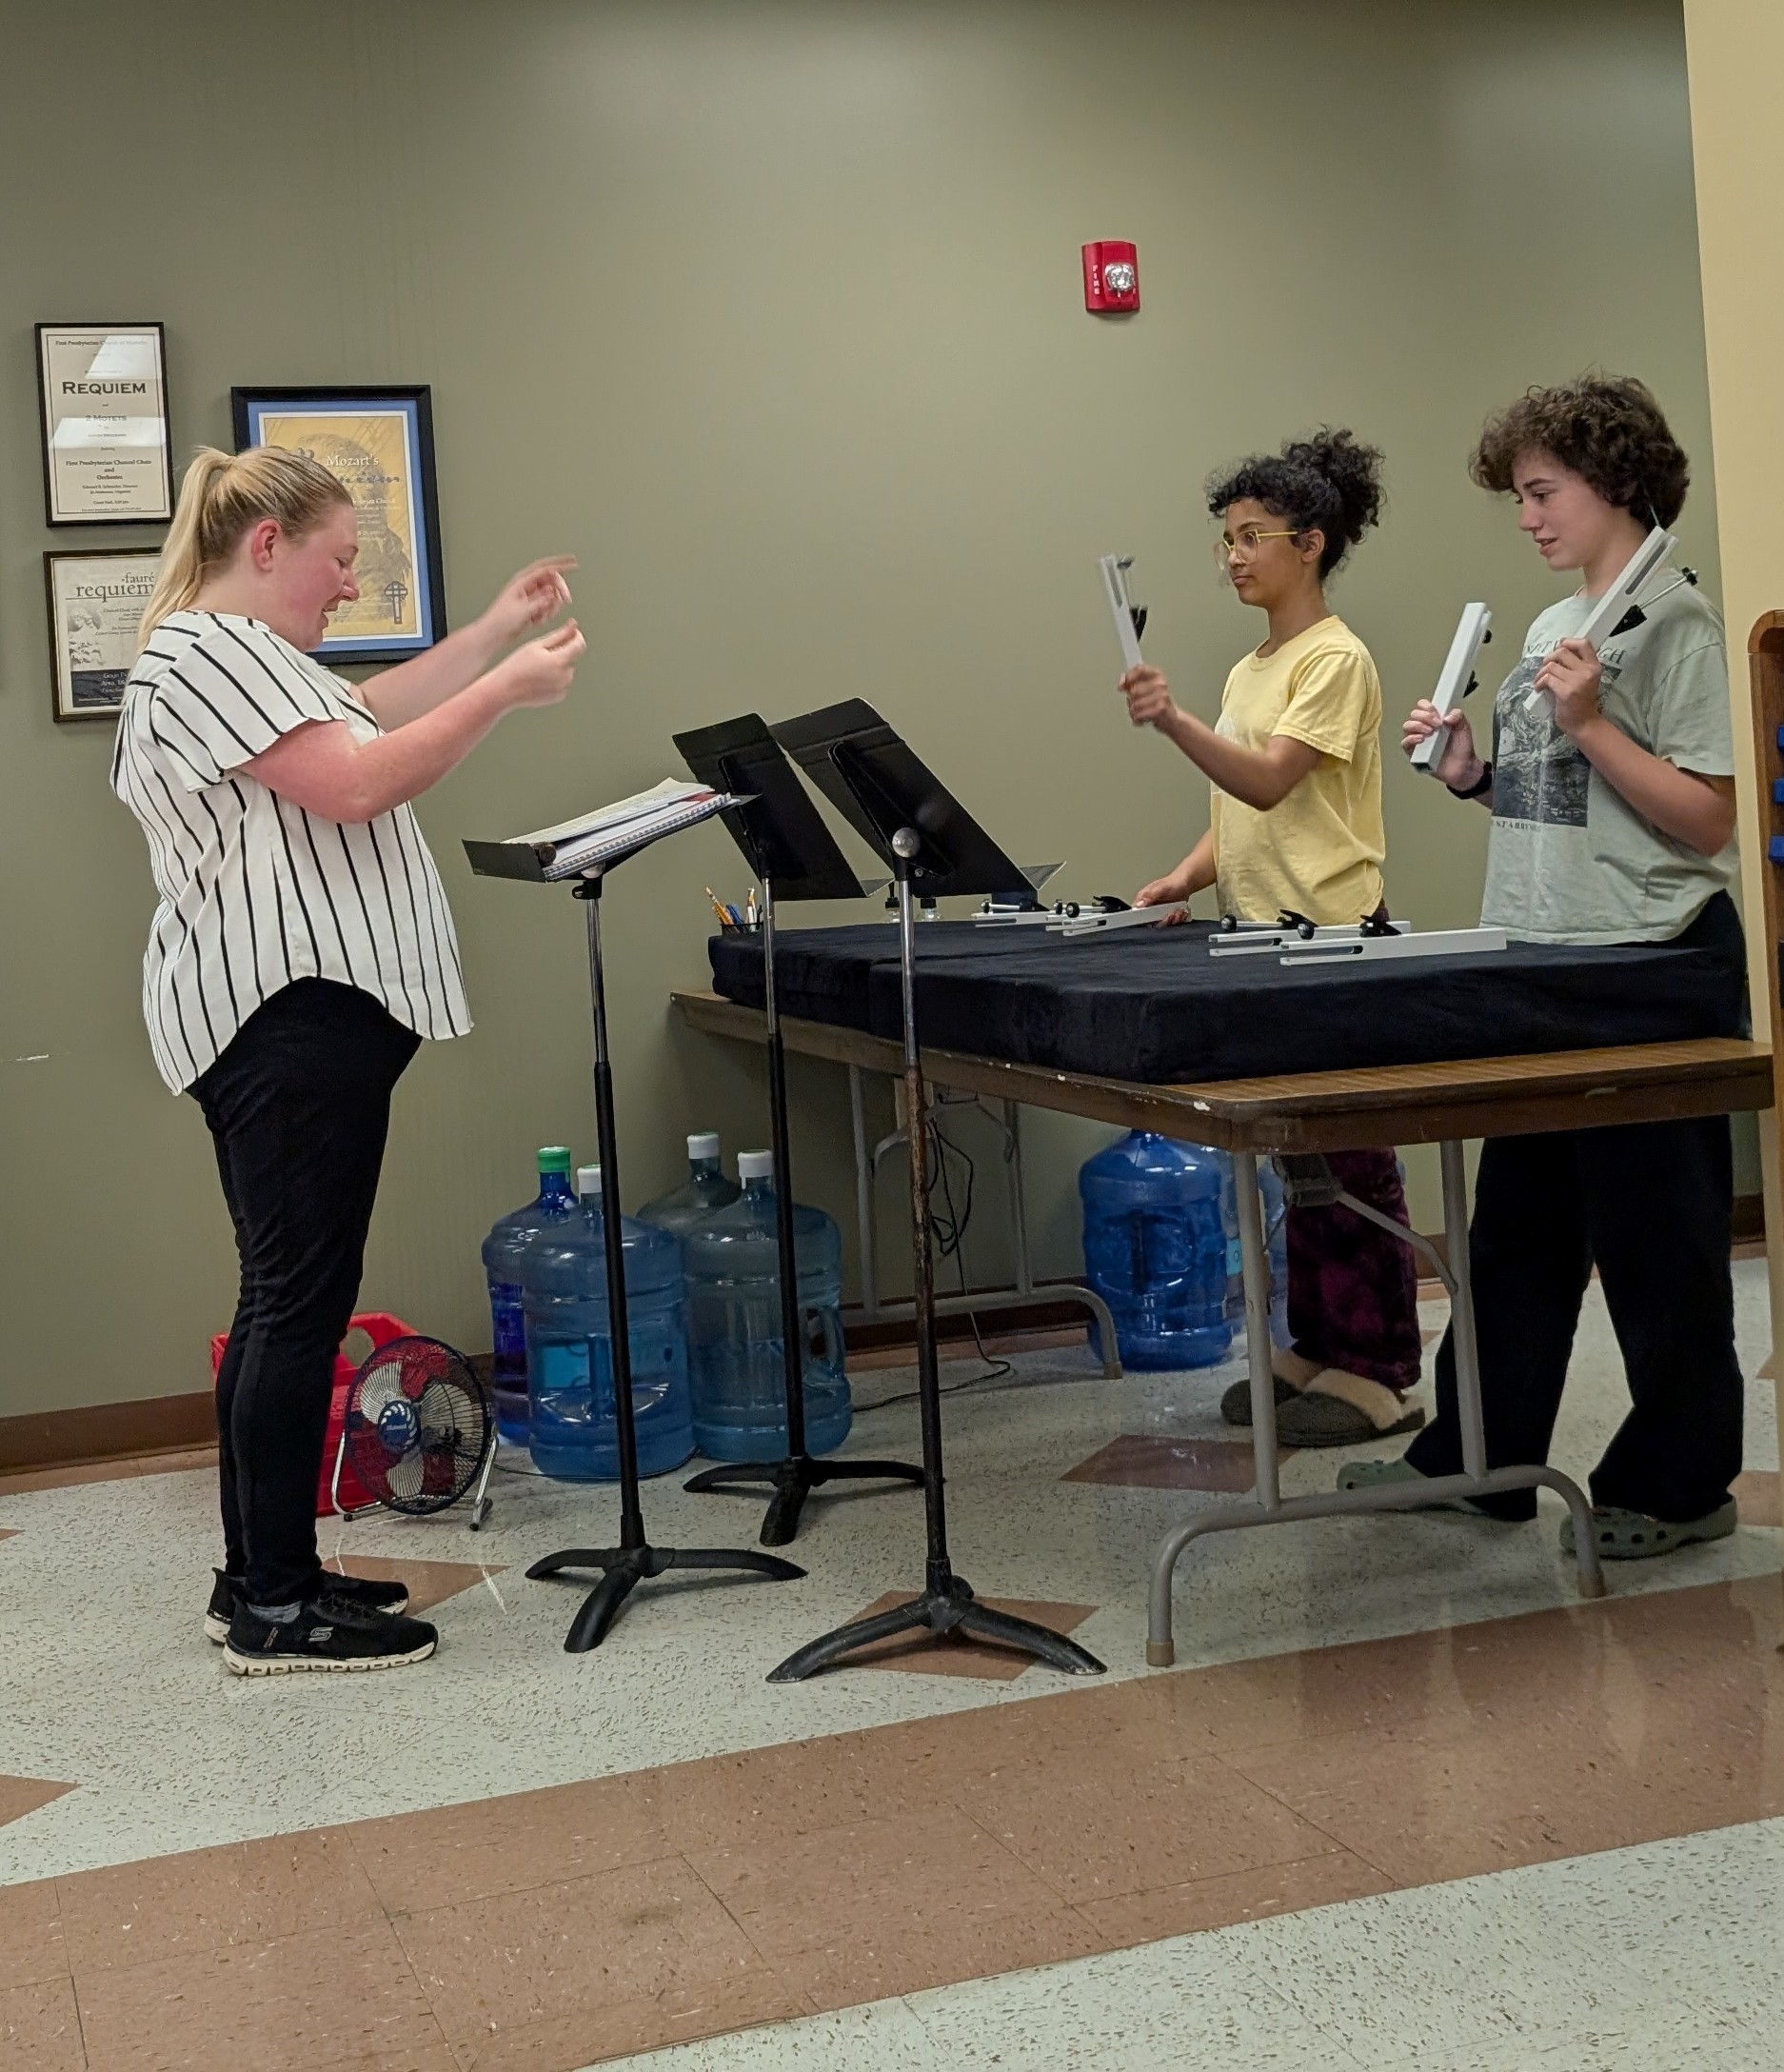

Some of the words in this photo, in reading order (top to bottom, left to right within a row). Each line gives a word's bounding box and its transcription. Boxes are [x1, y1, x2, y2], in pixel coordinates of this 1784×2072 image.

[1092, 264, 1100, 295] FIRE
[62, 381, 147, 395] REQUIEM
[327, 453, 380, 468] Mozart's
[76, 584, 153, 603] requiem
